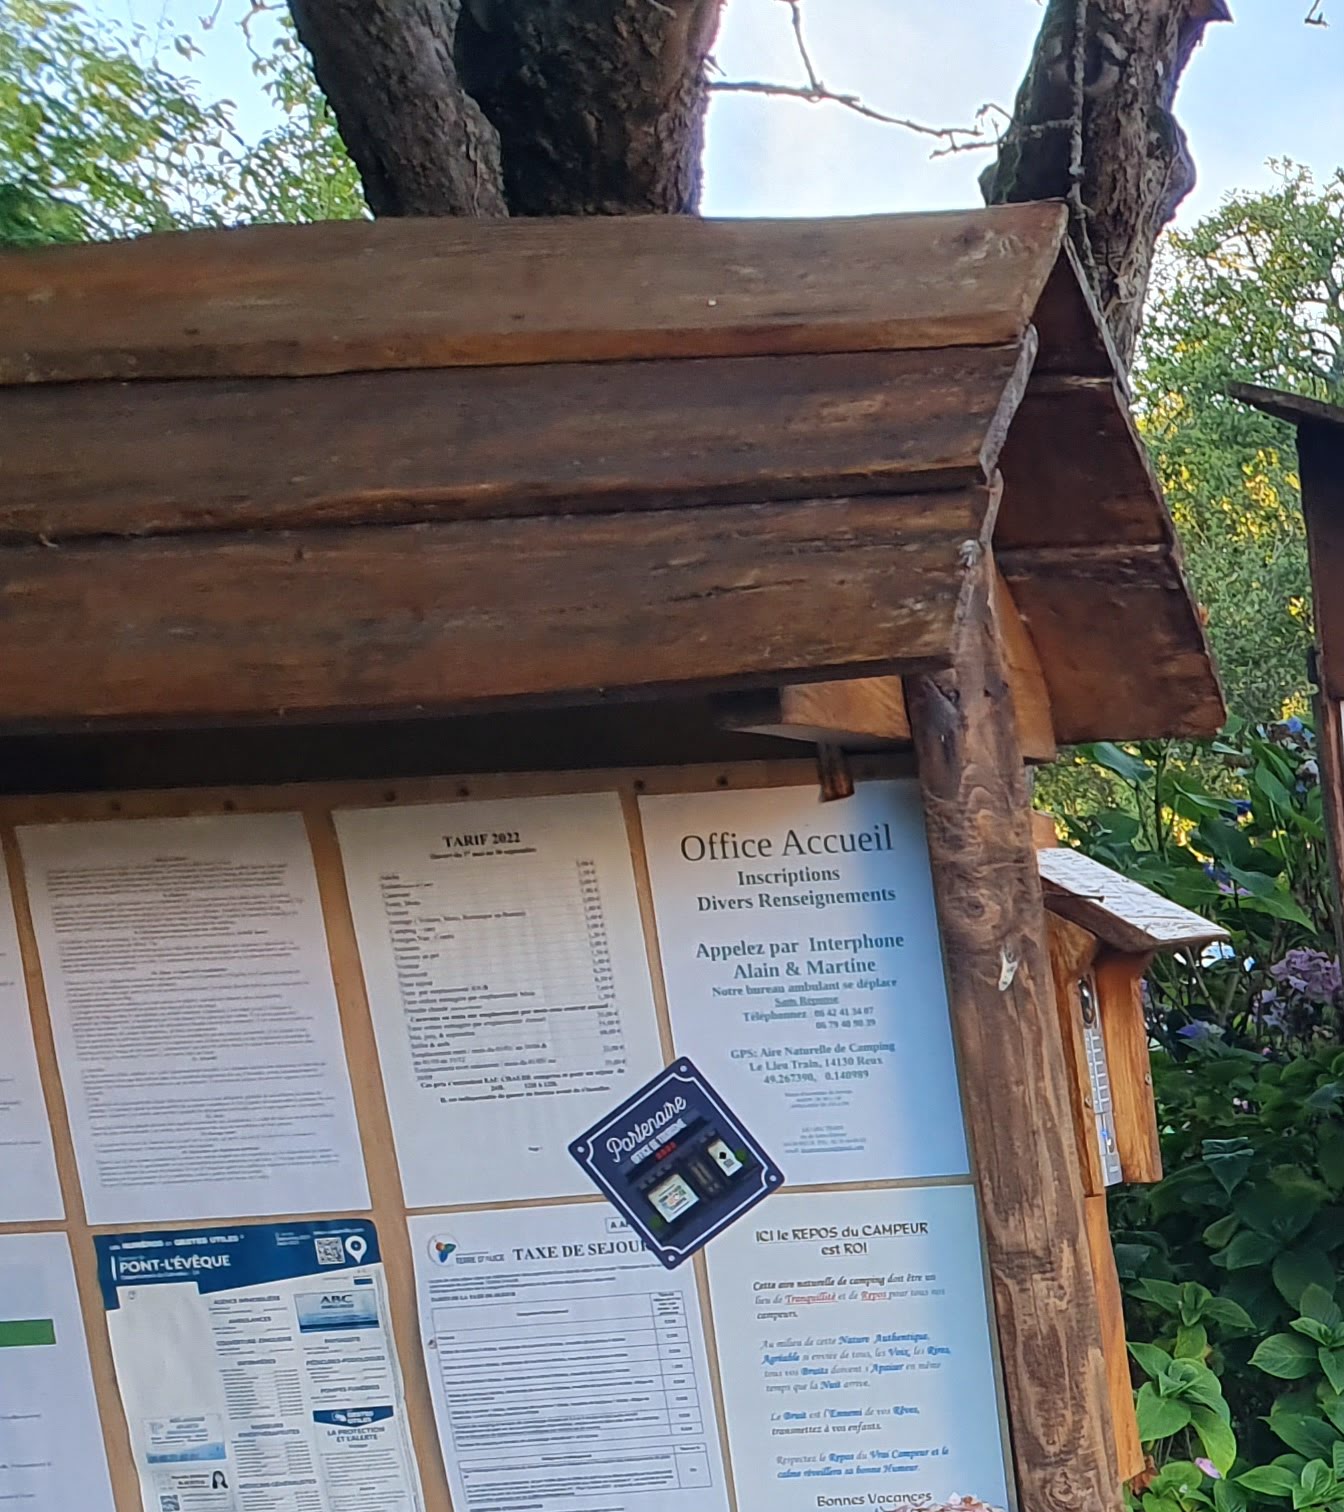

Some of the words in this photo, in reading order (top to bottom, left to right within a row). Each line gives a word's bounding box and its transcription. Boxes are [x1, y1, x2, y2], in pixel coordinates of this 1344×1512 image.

[442, 833, 488, 847] TARIF
[492, 832, 521, 844] 2022
[680, 831, 772, 861] Office
[782, 824, 895, 856] Accueil
[737, 866, 840, 886] Inscriptions
[698, 895, 754, 912] Divers
[759, 888, 896, 909] Renseignements
[696, 940, 765, 961] Appelez
[770, 940, 799, 956] par
[809, 933, 904, 953] Interphone
[733, 962, 780, 980] Alain
[785, 961, 802, 976] &
[807, 958, 876, 975] Martine
[712, 986, 743, 997] Notre
[746, 984, 785, 996] bureau
[788, 980, 840, 993] ambulant
[731, 1049, 757, 1059] GPS:
[760, 1047, 781, 1057] Aire
[784, 1045, 831, 1055] Naturelle
[834, 1044, 846, 1053] de
[849, 1041, 895, 1052] Camping
[750, 1062, 762, 1072] Le
[857, 1056, 883, 1065] Reux
[606, 1096, 687, 1162] Partenaire
[756, 1229, 773, 1242] ICI
[777, 1230, 789, 1240] le
[792, 1227, 838, 1240] REPOS
[842, 1226, 859, 1238] du
[862, 1222, 928, 1237] CAMPEUR
[513, 1246, 557, 1261] TAXE
[562, 1245, 584, 1259] DE
[821, 1244, 840, 1256] est
[844, 1242, 867, 1254] ROI
[120, 1254, 230, 1274] PONT-L'ÉVÊQUE
[753, 1280, 776, 1291] Cette
[837, 1276, 847, 1285] de
[849, 1275, 885, 1287] camping
[906, 1273, 922, 1282] être
[320, 1294, 353, 1304] ABC
[848, 1290, 858, 1300] de
[804, 1336, 814, 1346] de
[817, 1494, 865, 1507] Bonnes
[868, 1491, 932, 1505] Vacances
